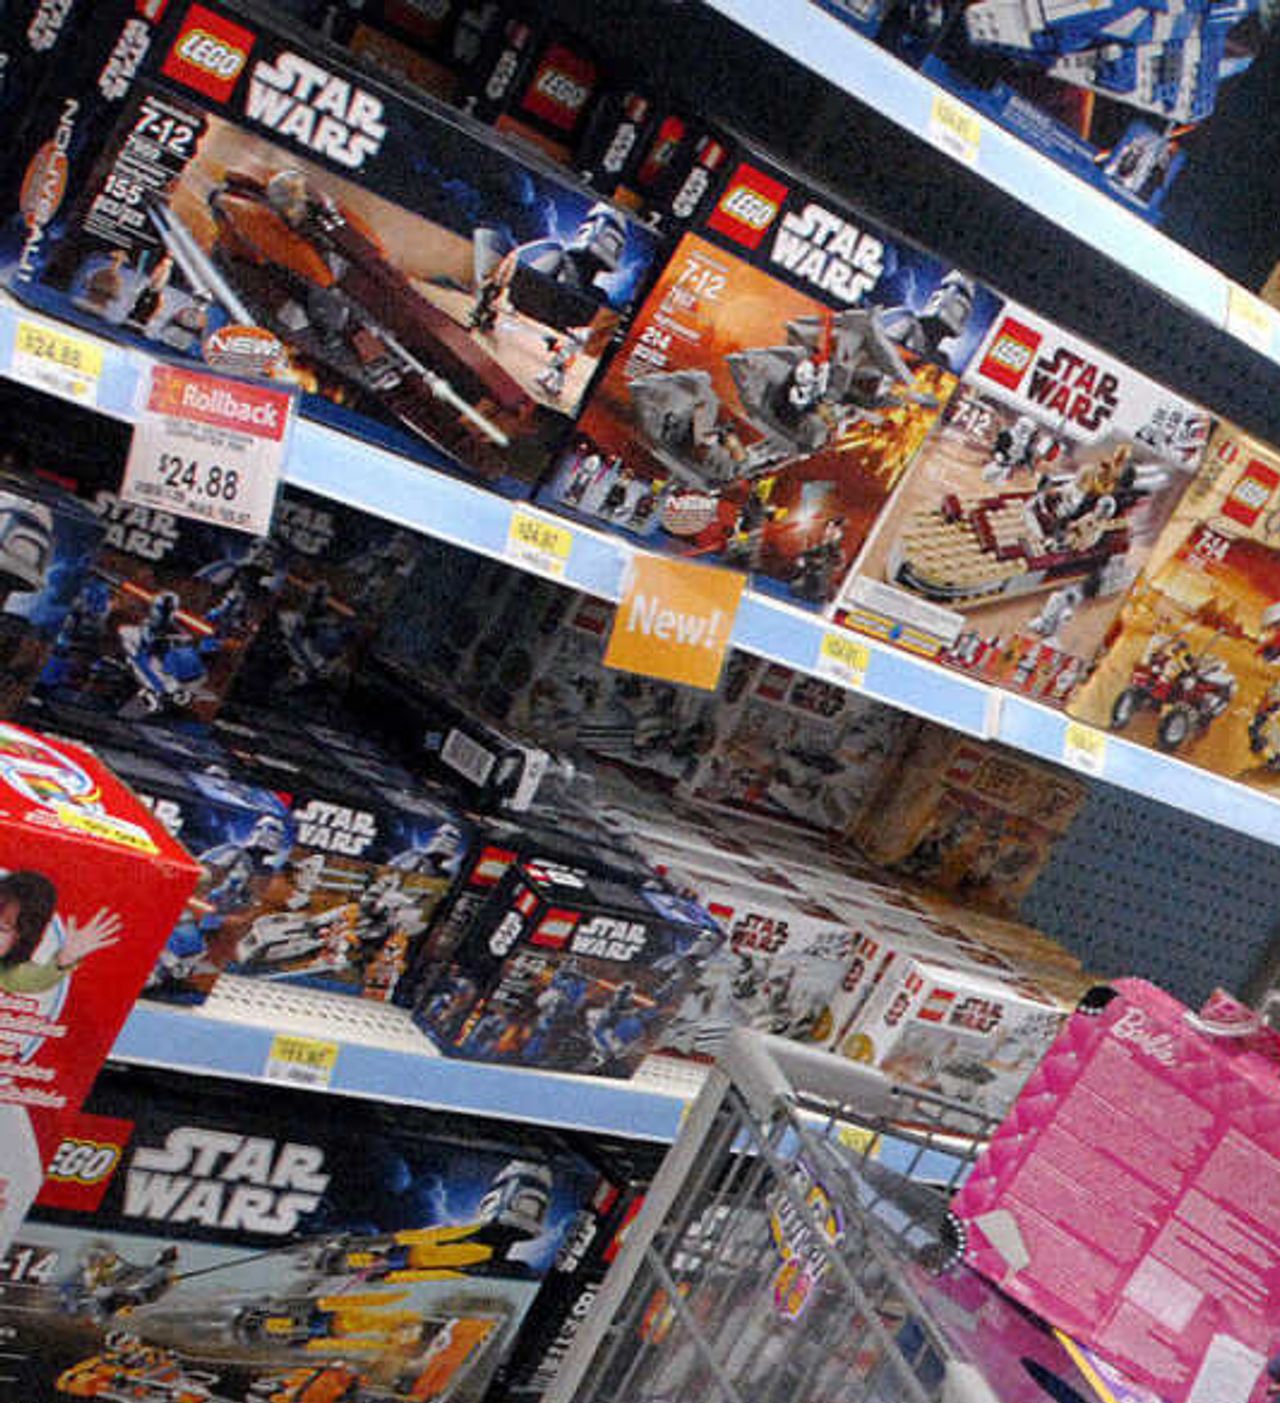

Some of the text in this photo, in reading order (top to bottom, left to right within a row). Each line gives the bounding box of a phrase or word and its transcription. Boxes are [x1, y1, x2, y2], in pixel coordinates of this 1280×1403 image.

[178, 31, 245, 79] LEGO
[253, 50, 388, 141] STAR
[135, 104, 194, 154] 7-12
[245, 80, 381, 171] WARS
[721, 187, 777, 229] LEGO
[771, 227, 875, 303] WARS
[779, 203, 884, 279] STAR
[1026, 368, 1113, 433] WARS
[1035, 347, 1118, 407] STAR
[182, 384, 280, 428] Rollback
[158, 453, 238, 501] $24.88
[103, 523, 175, 560] ARS
[628, 593, 719, 651] New!
[294, 800, 377, 838] STAR
[298, 823, 372, 856] WARS
[570, 936, 640, 961] WARS
[578, 917, 647, 944] STAR
[49, 1138, 117, 1181] EGO
[132, 1126, 332, 1195] STAR
[122, 1172, 321, 1235] WARS
[0, 1246, 58, 1283] -14
